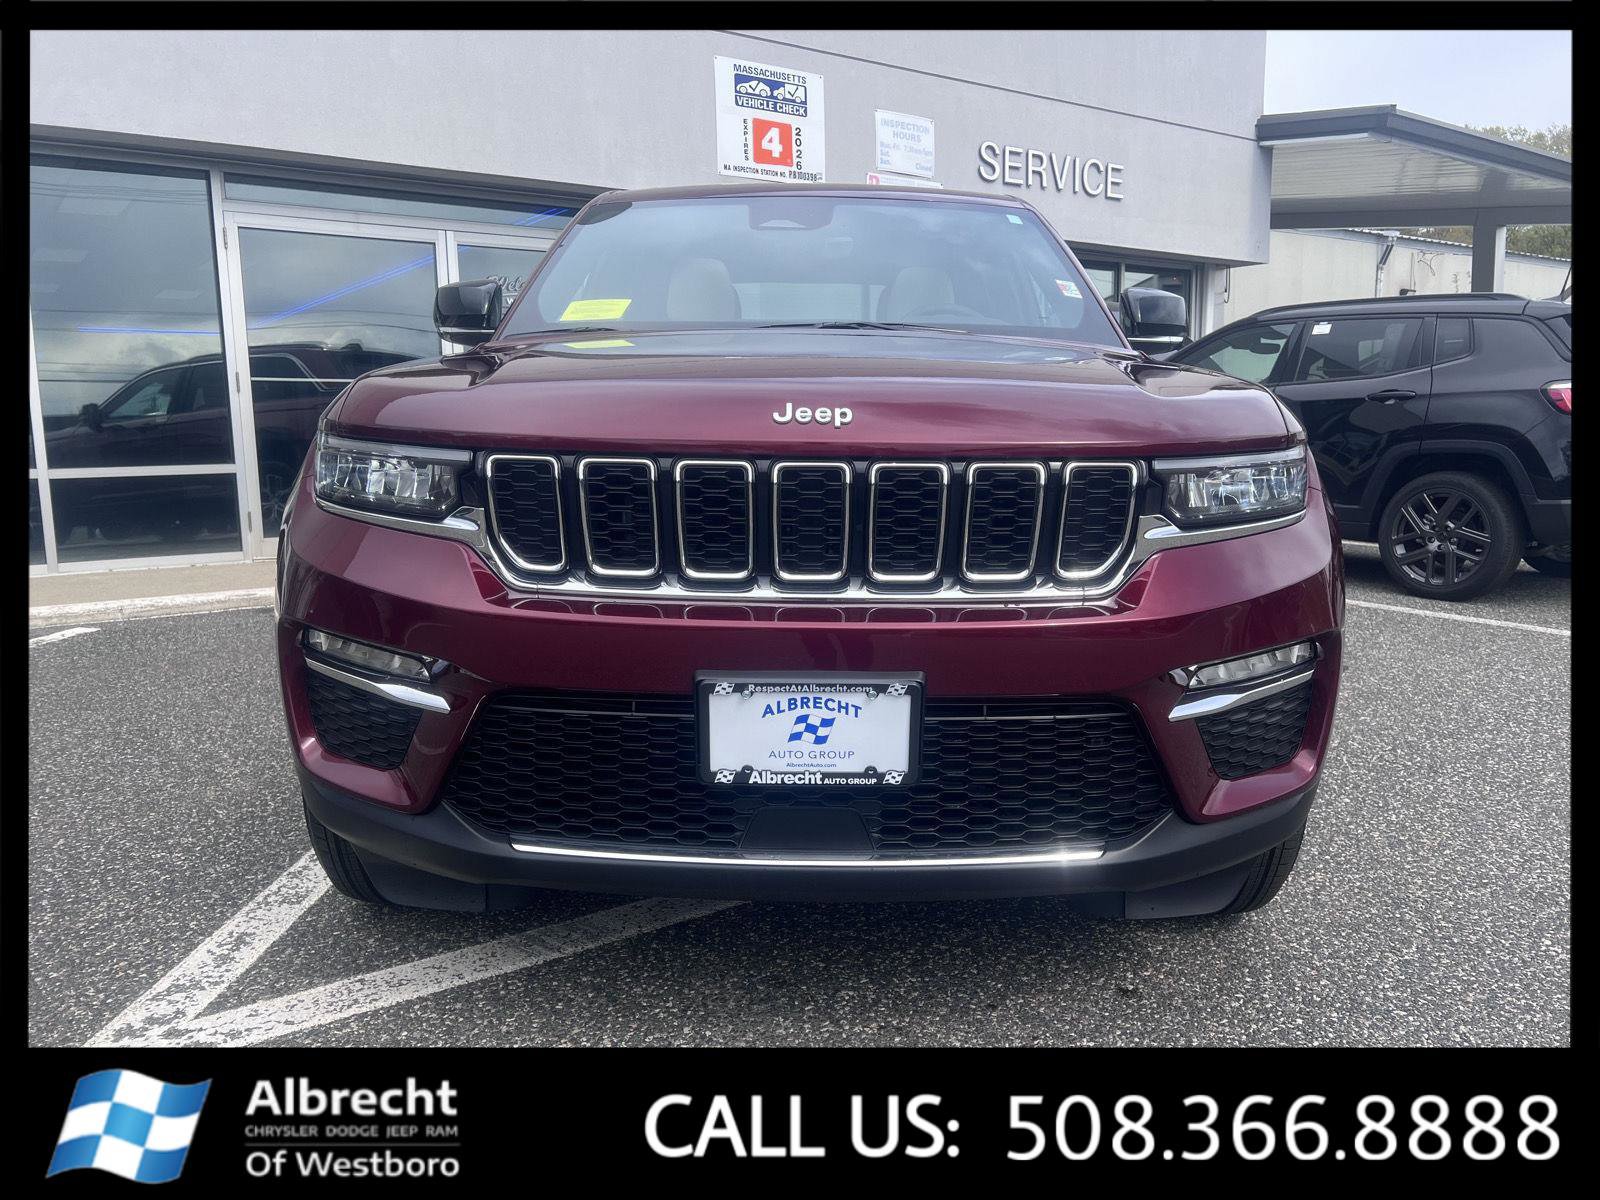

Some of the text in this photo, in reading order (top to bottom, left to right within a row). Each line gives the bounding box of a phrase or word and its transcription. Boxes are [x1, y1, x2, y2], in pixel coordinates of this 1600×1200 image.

[733, 63, 807, 85] MASSACHUSETTS
[736, 96, 807, 117] VEHICLE CHECK
[880, 118, 930, 135] INSPECTION
[892, 130, 922, 143] HOURS
[761, 127, 783, 158] 4
[794, 127, 803, 170] 2026
[733, 165, 760, 175] INSPECTION
[760, 169, 779, 178] STATION
[978, 141, 1124, 201] SERVICE
[772, 402, 853, 429] Jeep
[748, 684, 873, 694] RespectAtAlbrecht.com
[762, 696, 862, 718] ALBRECHT
[768, 750, 855, 759] AUTO GROUP
[748, 769, 823, 784] Albrecht
